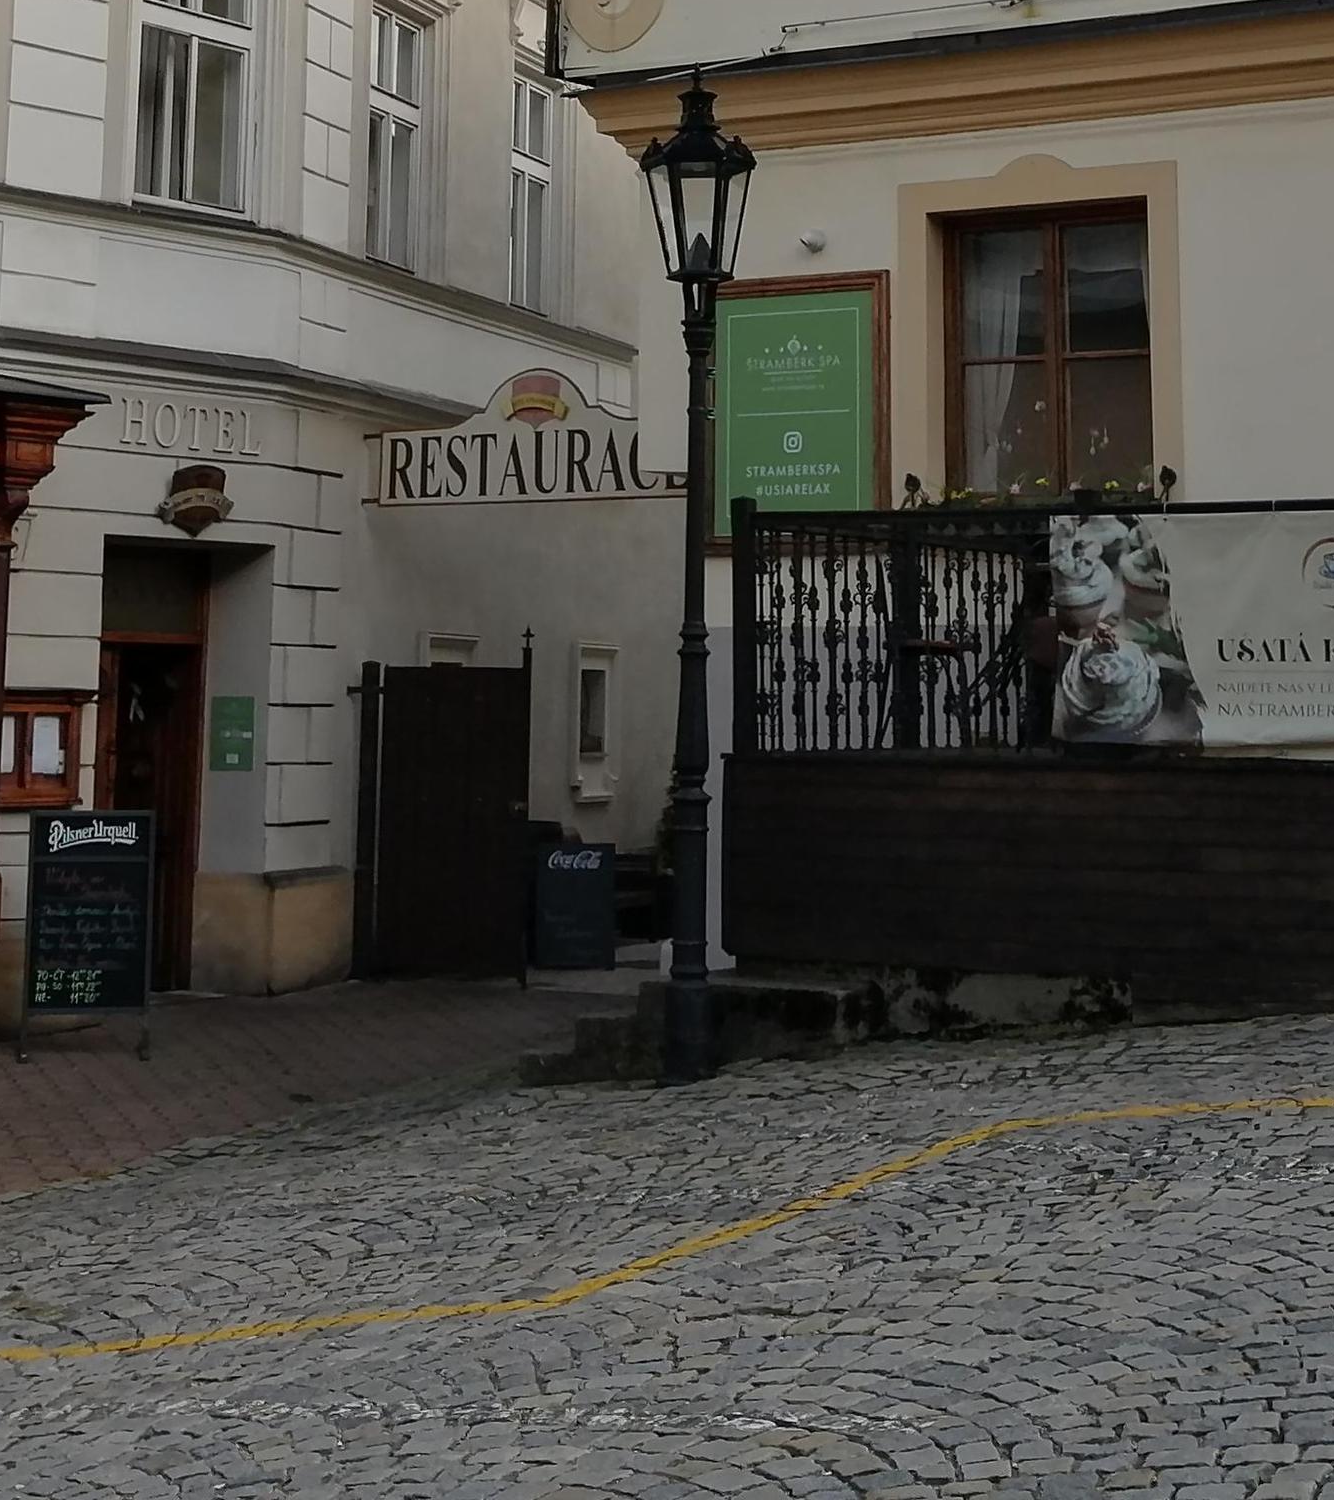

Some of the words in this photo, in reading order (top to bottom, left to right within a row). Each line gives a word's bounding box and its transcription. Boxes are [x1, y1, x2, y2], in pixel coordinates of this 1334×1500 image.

[818, 355, 841, 368] SPA
[120, 398, 262, 457] HOTEL
[388, 427, 689, 499] RESTAURAC
[746, 463, 841, 479] STRAMBERKSPA
[1308, 683, 1318, 694] V
[1218, 702, 1244, 717] NA
[48, 820, 95, 853] Pilsner
[92, 819, 135, 847] Urquell
